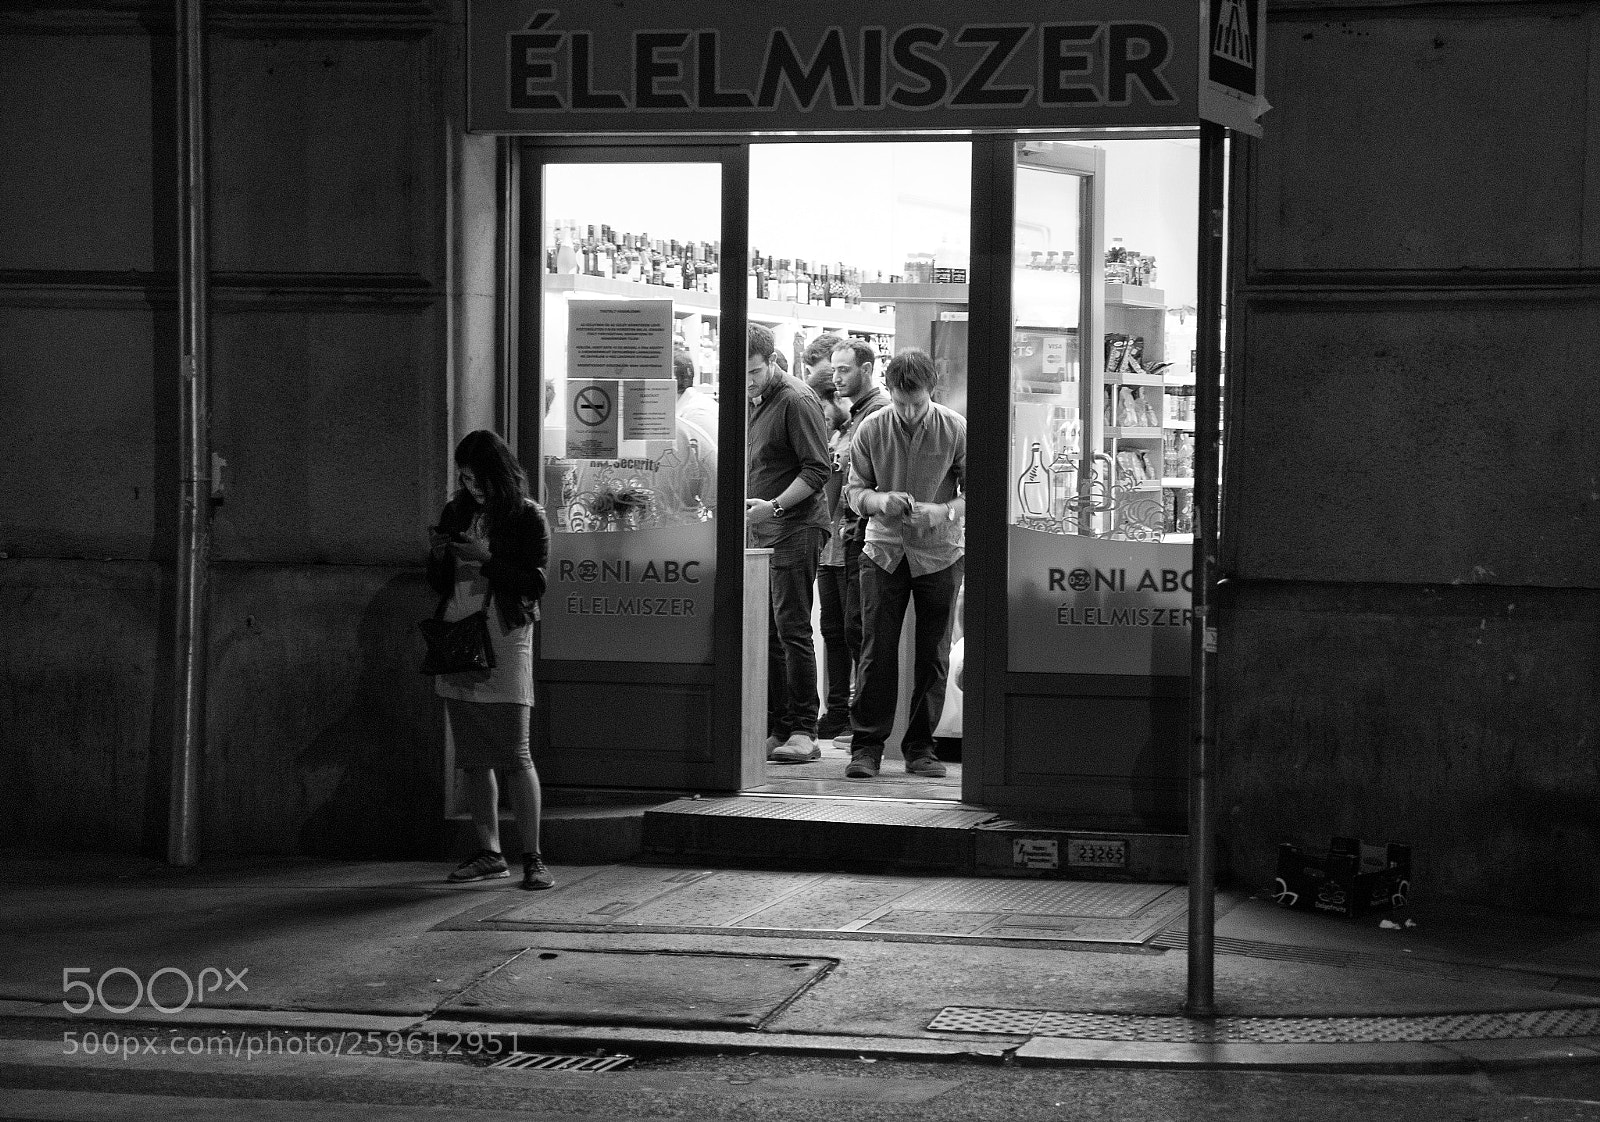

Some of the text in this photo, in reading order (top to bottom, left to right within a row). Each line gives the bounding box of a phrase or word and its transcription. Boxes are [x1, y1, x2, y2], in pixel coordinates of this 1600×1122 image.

[507, 10, 1181, 111] ÉLELMISZER
[559, 559, 700, 584] RONI ABC
[1048, 568, 1125, 592] RONI
[567, 591, 696, 616] ÉLELMISZER
[1057, 602, 1193, 627] ÉLELMISZER
